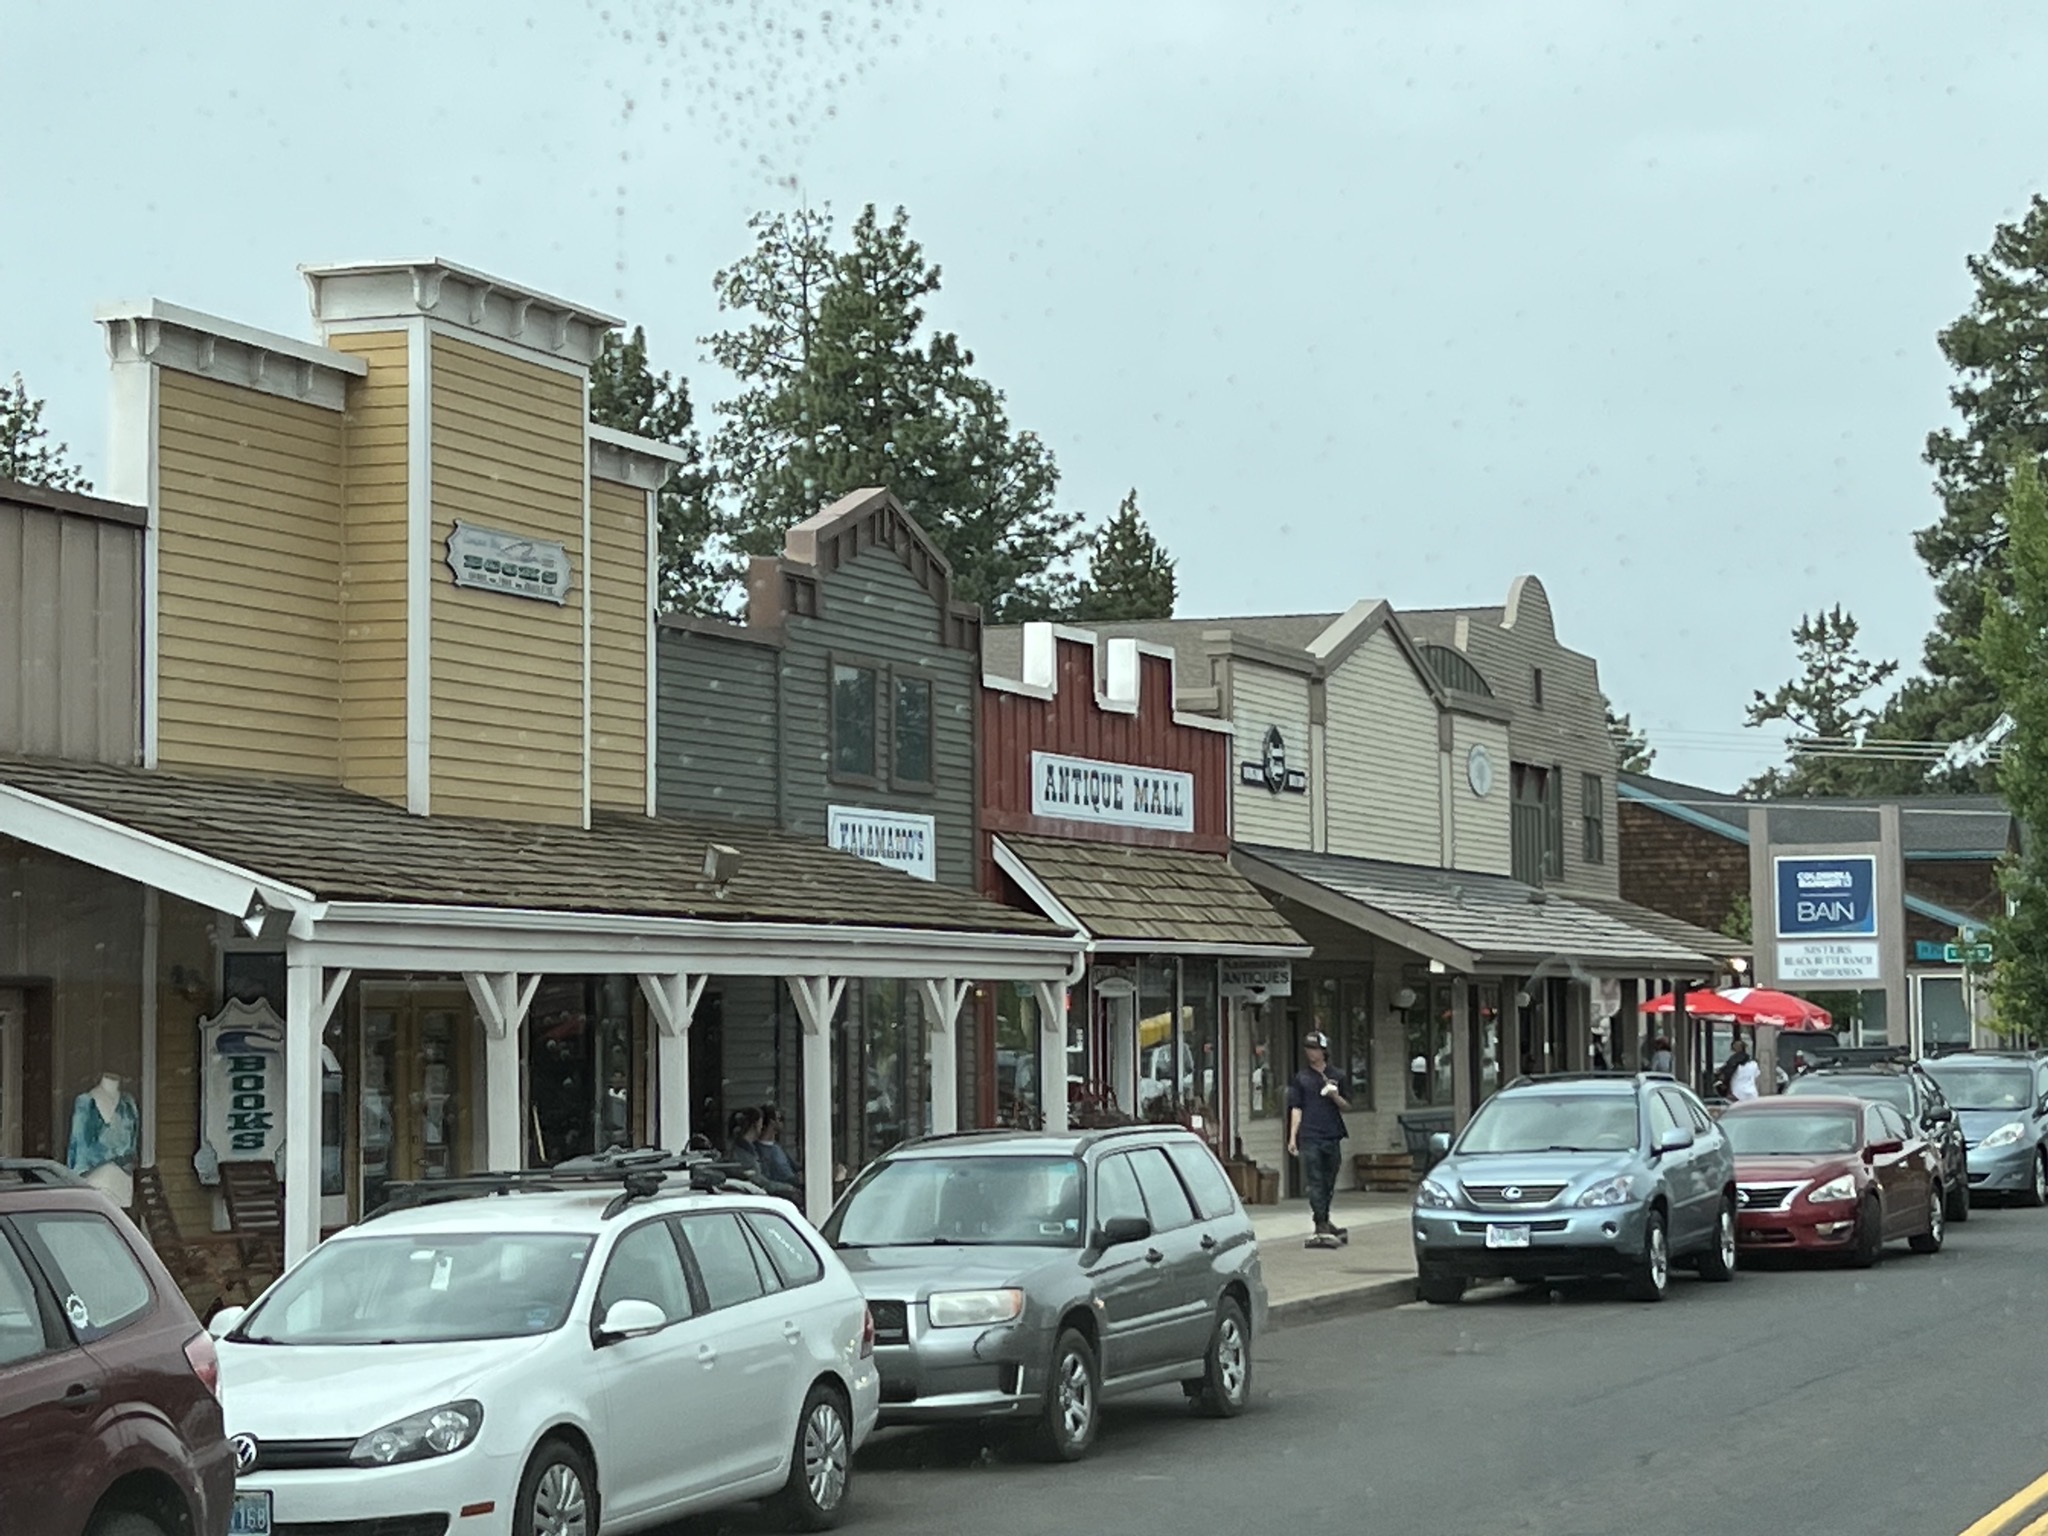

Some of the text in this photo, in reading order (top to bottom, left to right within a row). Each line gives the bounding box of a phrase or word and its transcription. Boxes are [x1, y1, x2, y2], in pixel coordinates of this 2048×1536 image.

[1044, 763, 1184, 818] ANTIQUE MALL
[1797, 900, 1856, 923] BAIN
[1222, 971, 1289, 985] ANTIQUES
[228, 1056, 273, 1150] BOOKS
